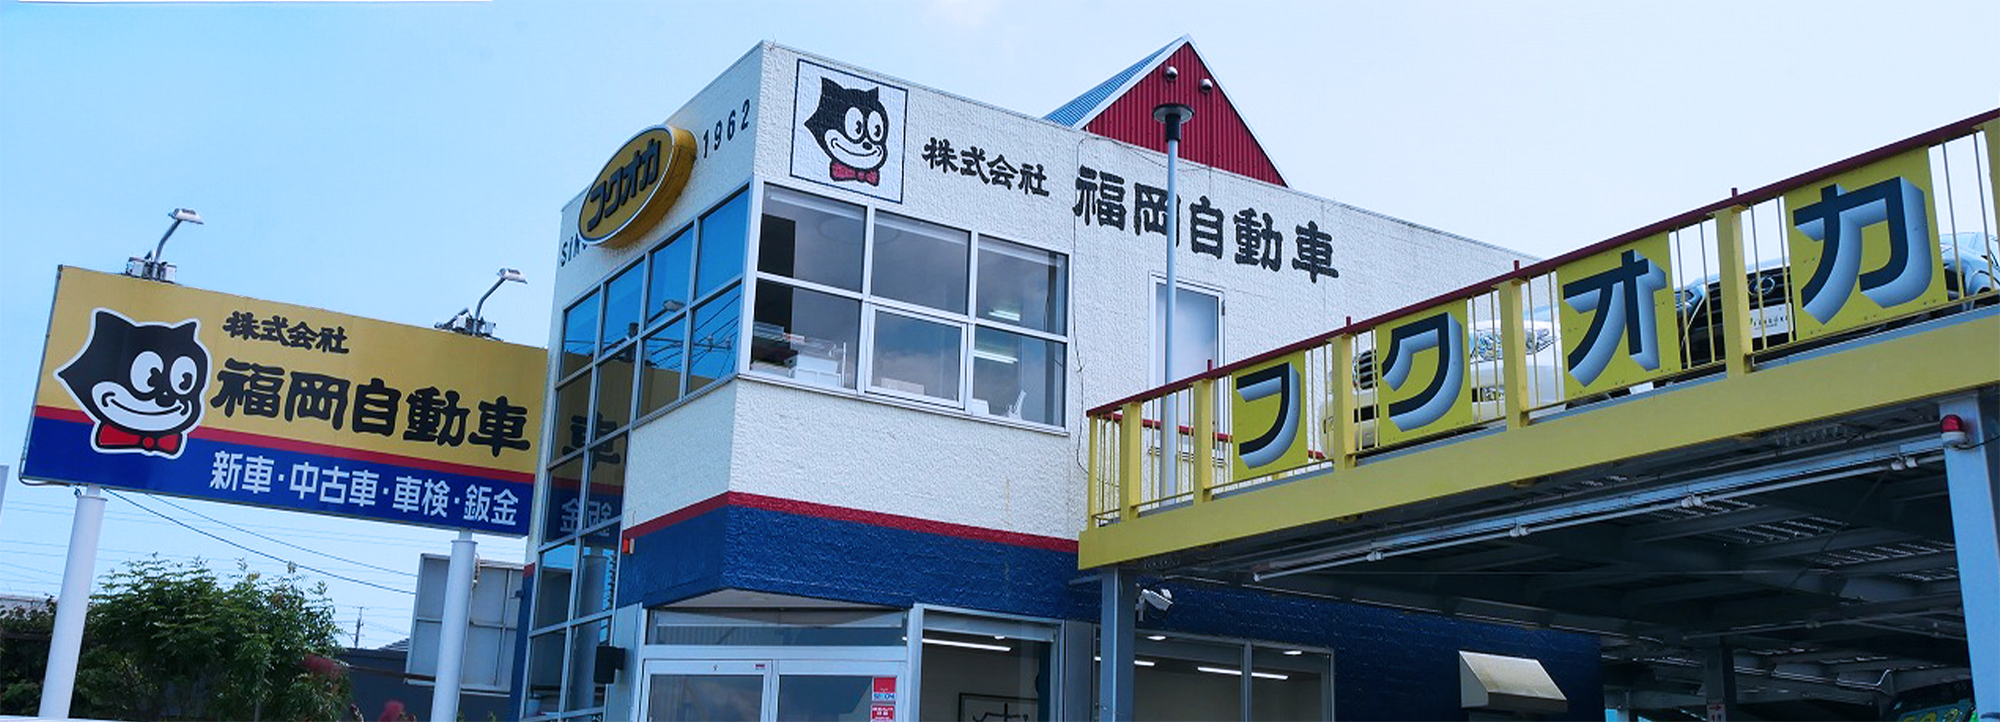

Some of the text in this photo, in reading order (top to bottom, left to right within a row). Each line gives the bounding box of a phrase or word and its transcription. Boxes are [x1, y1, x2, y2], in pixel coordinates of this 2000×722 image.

[702, 99, 750, 158] 1962
[922, 136, 1050, 198] 株式会社
[586, 138, 661, 232] フクオカ
[1072, 165, 1339, 284] 福岡自動車
[222, 310, 350, 354] 株式会社
[1236, 176, 1935, 470] フクオカ
[210, 357, 531, 457] 福岡自動車
